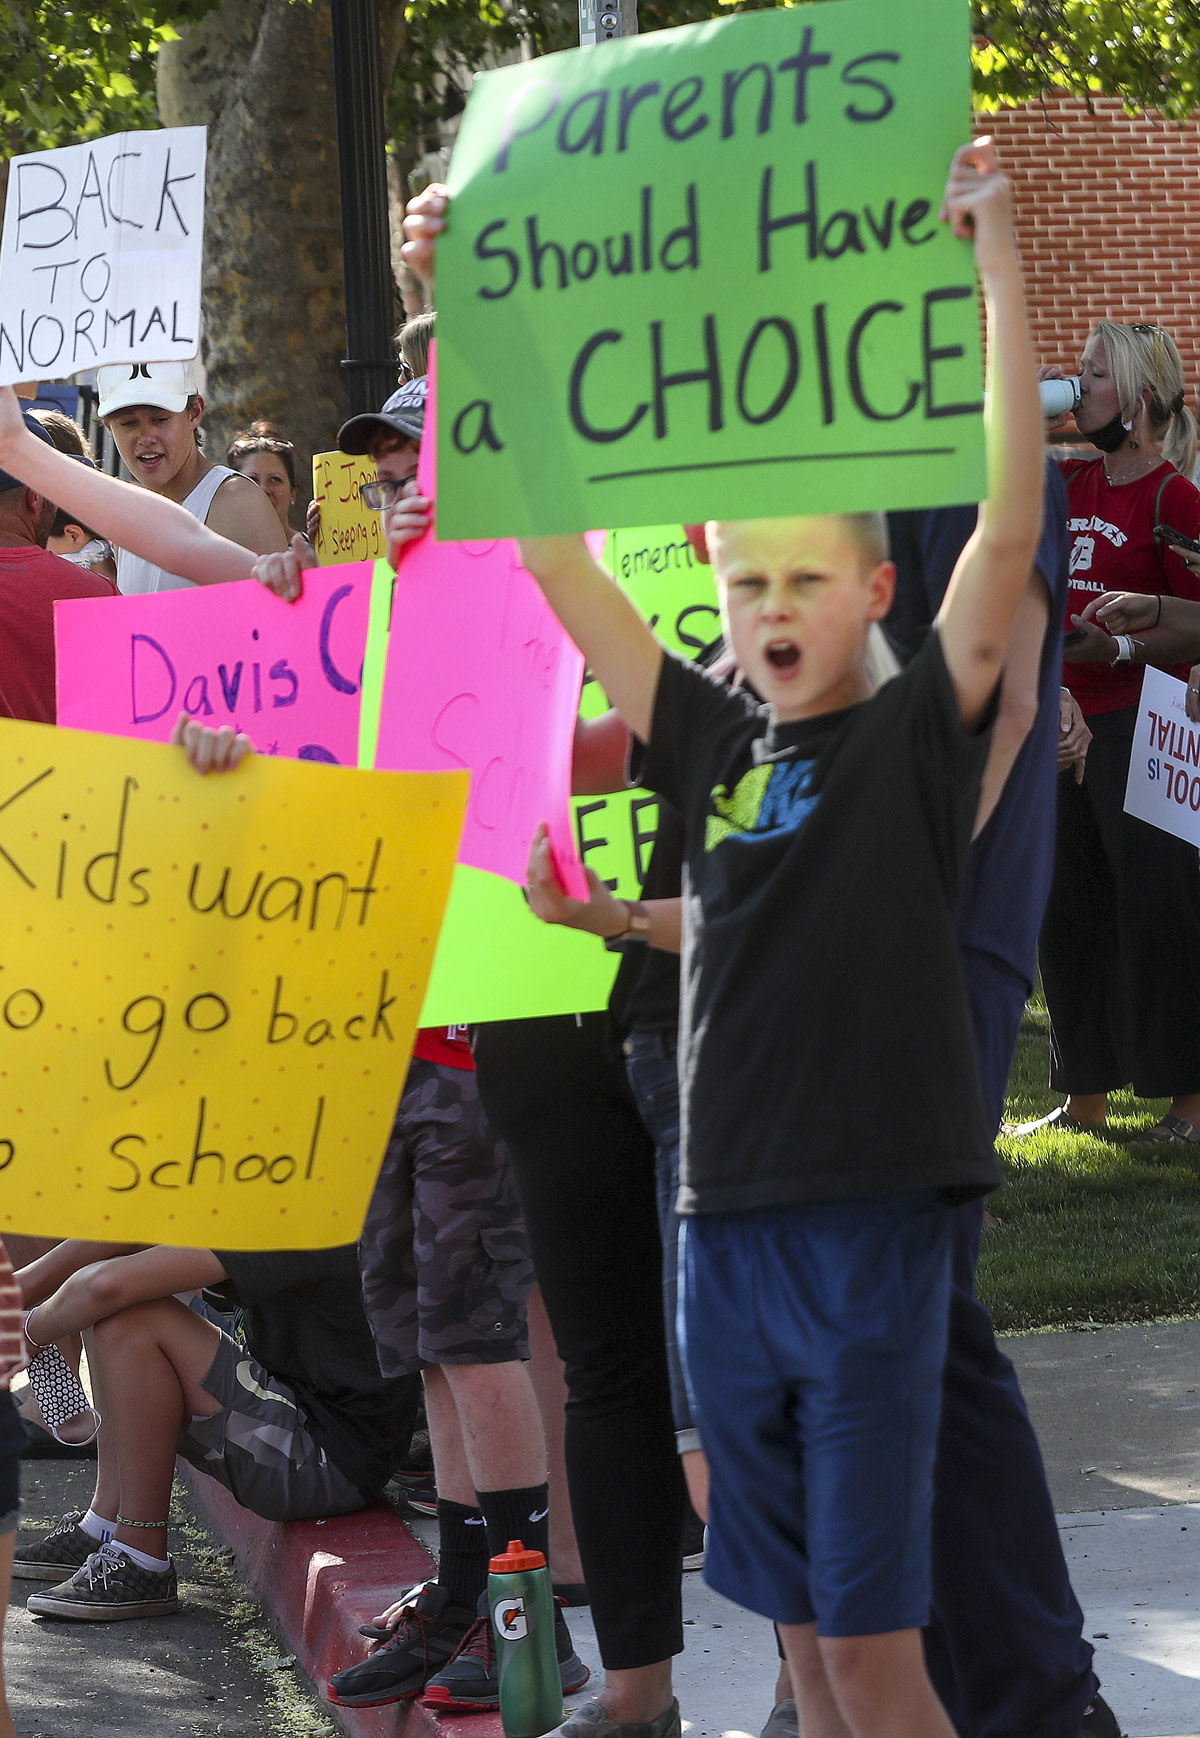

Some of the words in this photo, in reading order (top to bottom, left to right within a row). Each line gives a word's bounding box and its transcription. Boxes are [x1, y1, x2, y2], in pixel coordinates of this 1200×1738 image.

[492, 26, 901, 173] Parents
[16, 147, 196, 253] BACK
[474, 183, 699, 300] Should
[757, 160, 937, 272] Have
[32, 251, 111, 304] TO
[451, 398, 505, 454] a
[567, 286, 984, 444] CHOICE
[131, 628, 299, 724] Davis
[1147, 758, 1160, 780] IS
[189, 838, 383, 933] want
[105, 992, 230, 1091] go
[268, 970, 397, 1047] back
[109, 1096, 325, 1192] school
